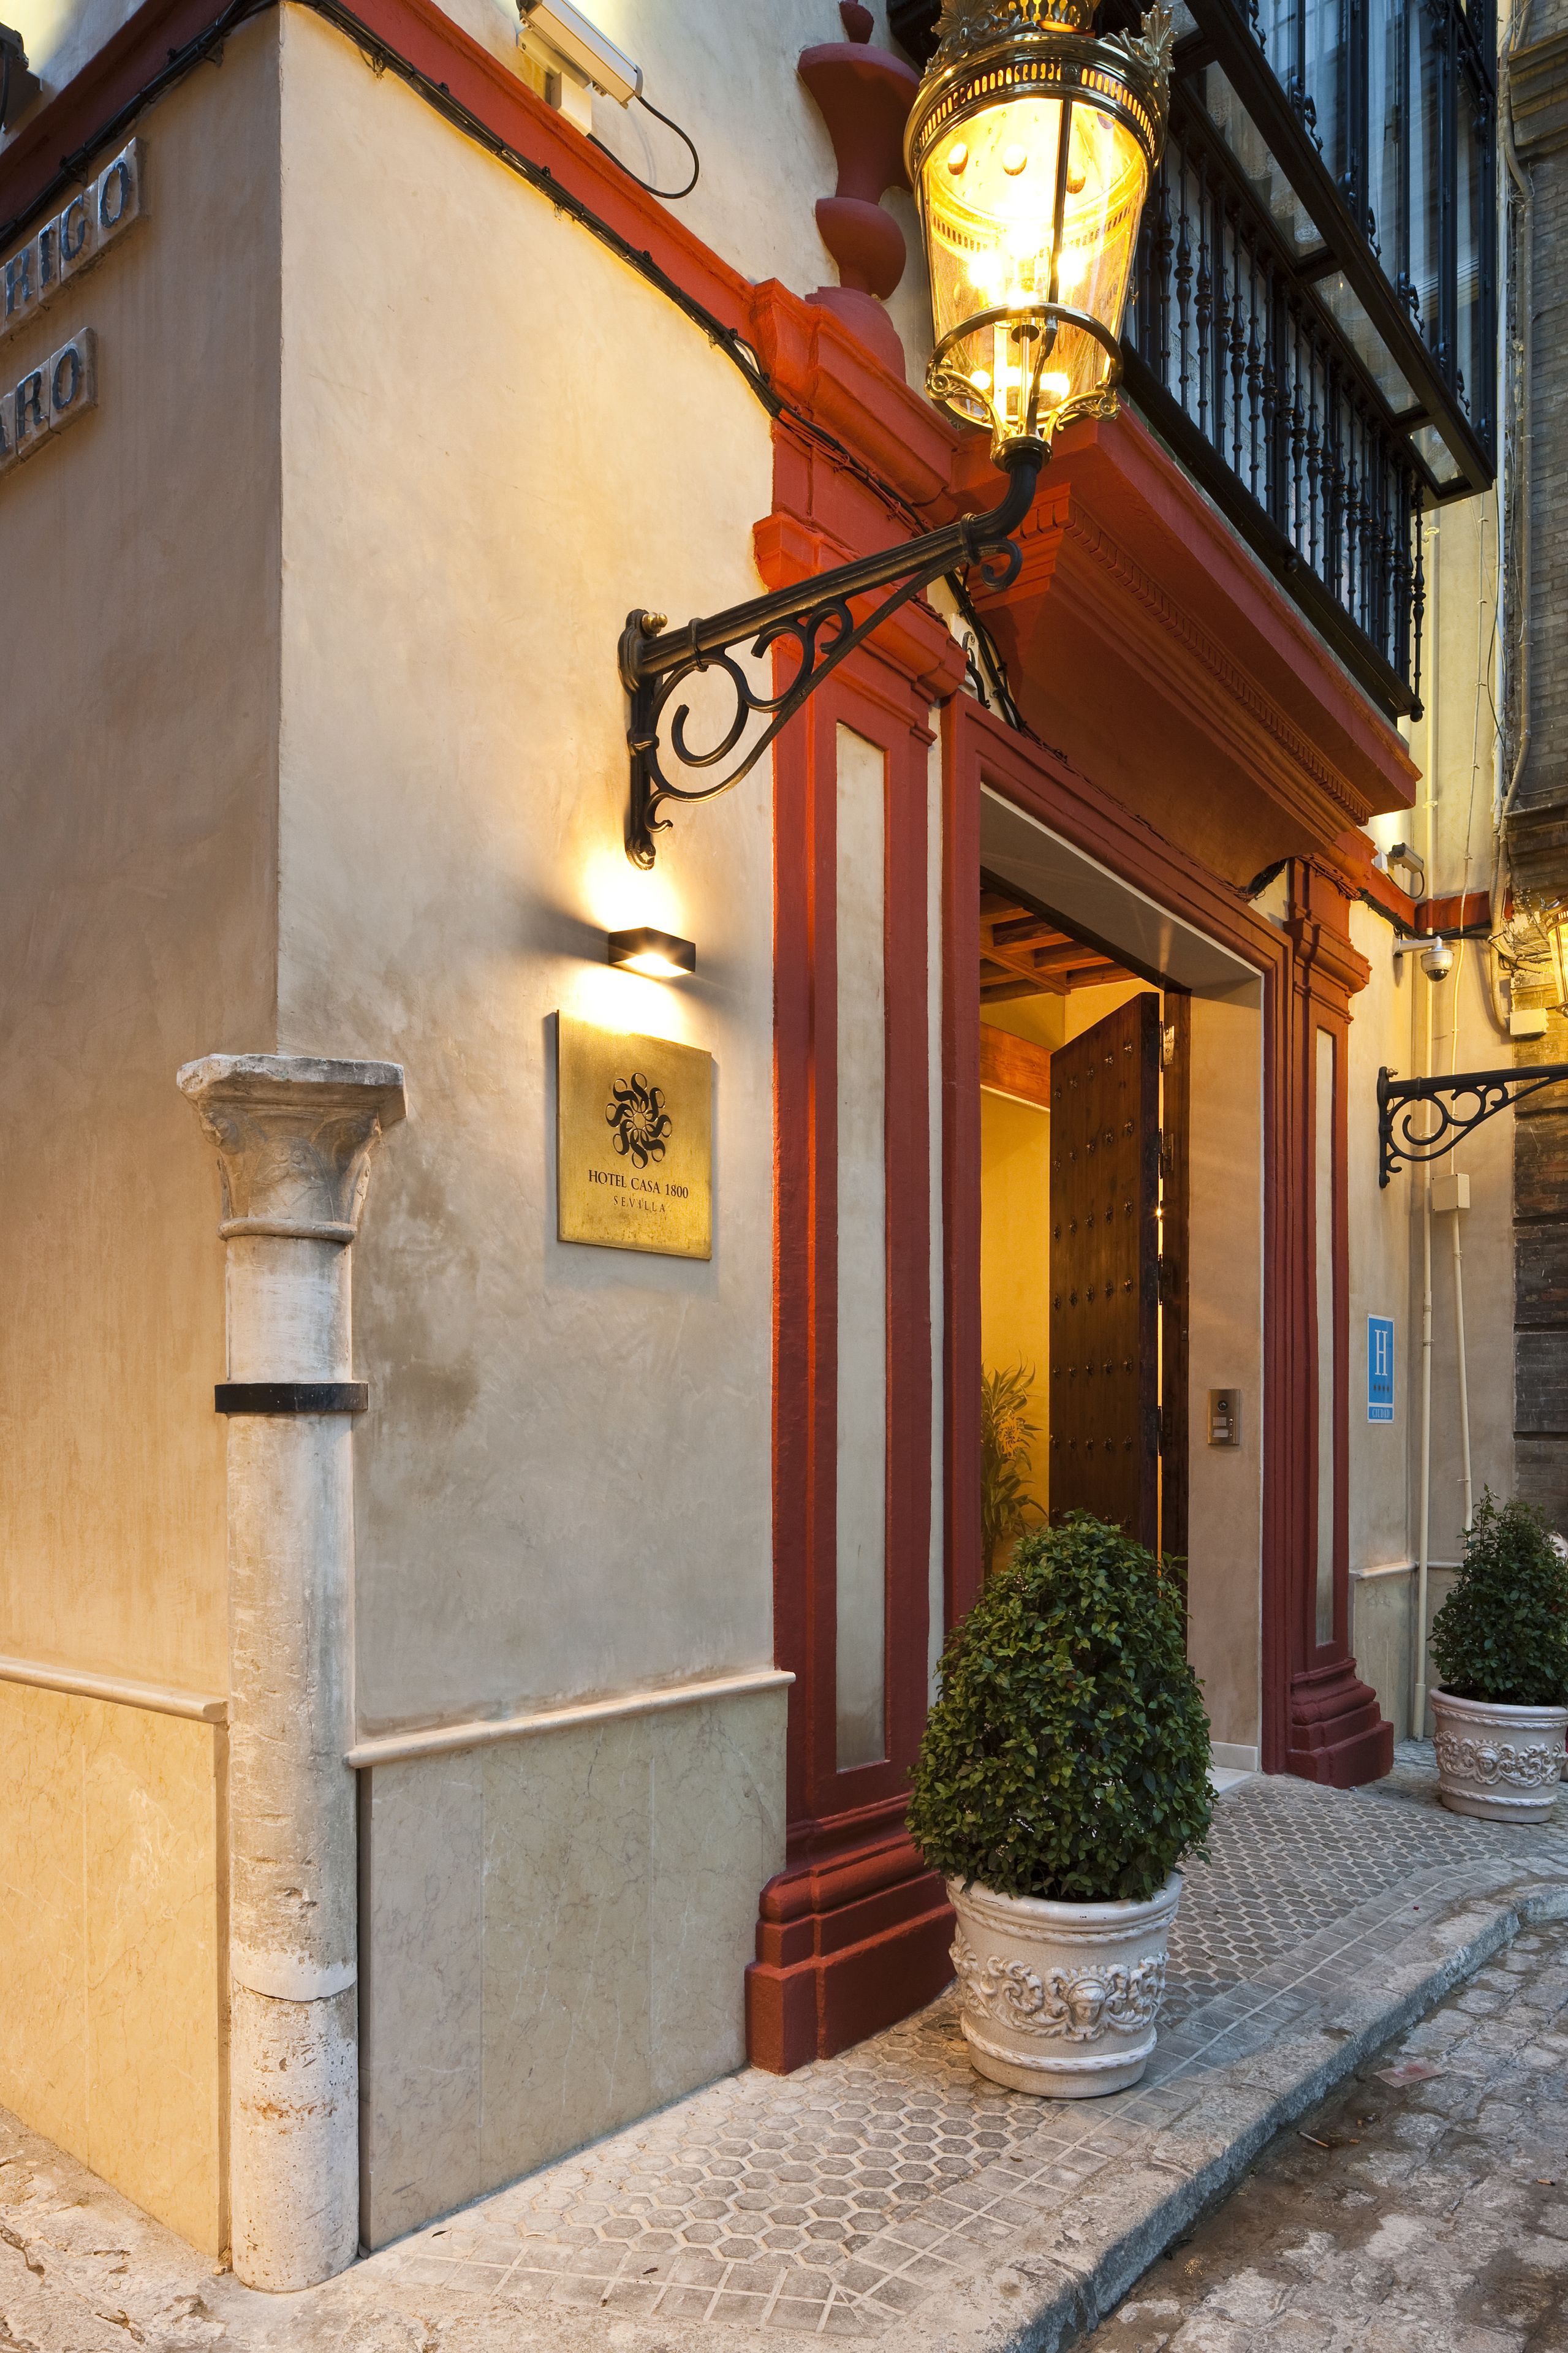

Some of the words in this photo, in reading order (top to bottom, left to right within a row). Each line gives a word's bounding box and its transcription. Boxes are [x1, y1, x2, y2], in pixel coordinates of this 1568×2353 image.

[588, 1170, 627, 1188] HOTEL
[631, 1177, 661, 1194] CASA
[665, 1183, 689, 1199] 1800
[613, 1195, 665, 1213] SEVILLA
[1375, 1330, 1387, 1376] H
[1372, 1408, 1390, 1419] CIUDAD
